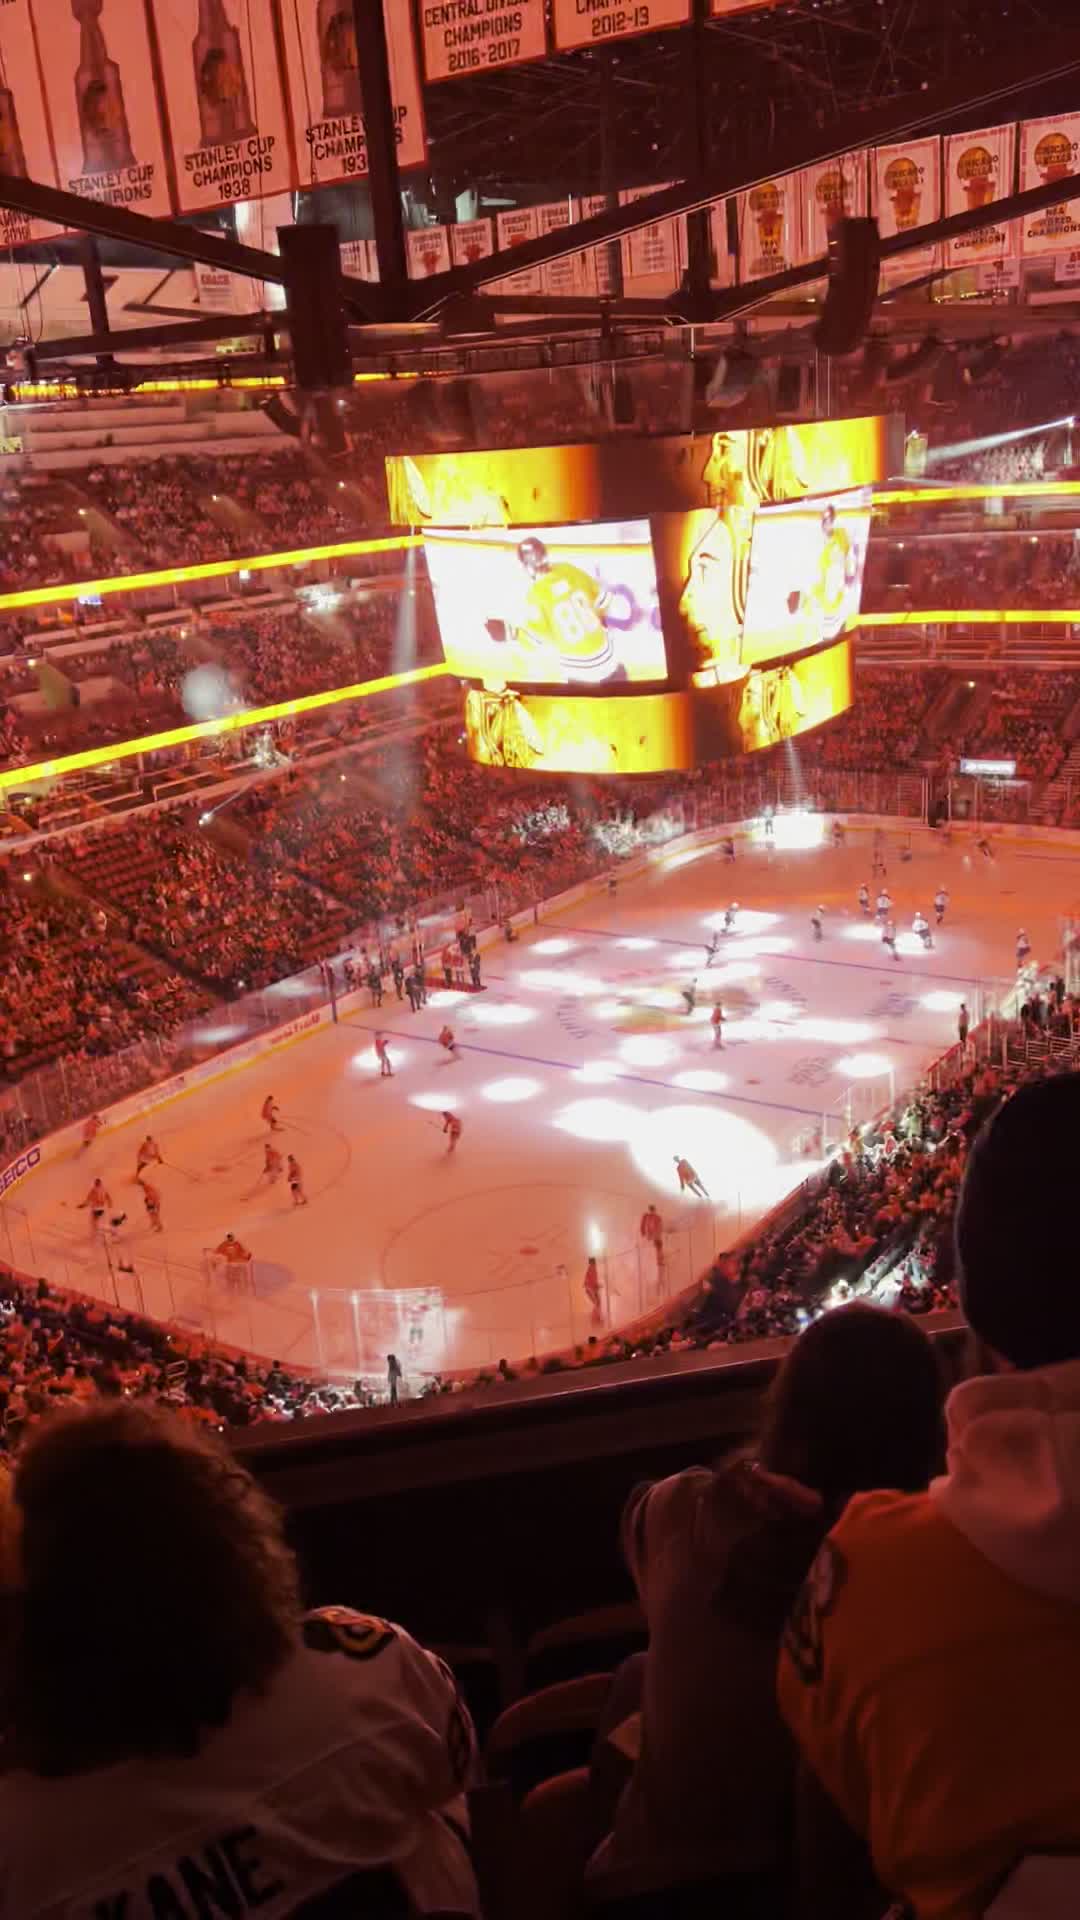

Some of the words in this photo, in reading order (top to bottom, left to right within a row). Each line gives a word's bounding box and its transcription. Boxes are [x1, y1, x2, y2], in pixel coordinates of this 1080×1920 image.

[424, 0, 483, 28] CENTRAL
[591, 6, 649, 37] 2012-13
[443, 12, 522, 48] CHAMPIONS
[448, 38, 520, 72] 2016-2017
[306, 115, 367, 144] STANLE
[184, 144, 241, 171] STANLEY
[247, 136, 275, 156] CUP
[342, 153, 367, 174] 193
[68, 169, 122, 194] STANLEY
[127, 165, 154, 184] CUP
[193, 155, 272, 188] CHAMPIONS
[218, 178, 251, 200] 1938
